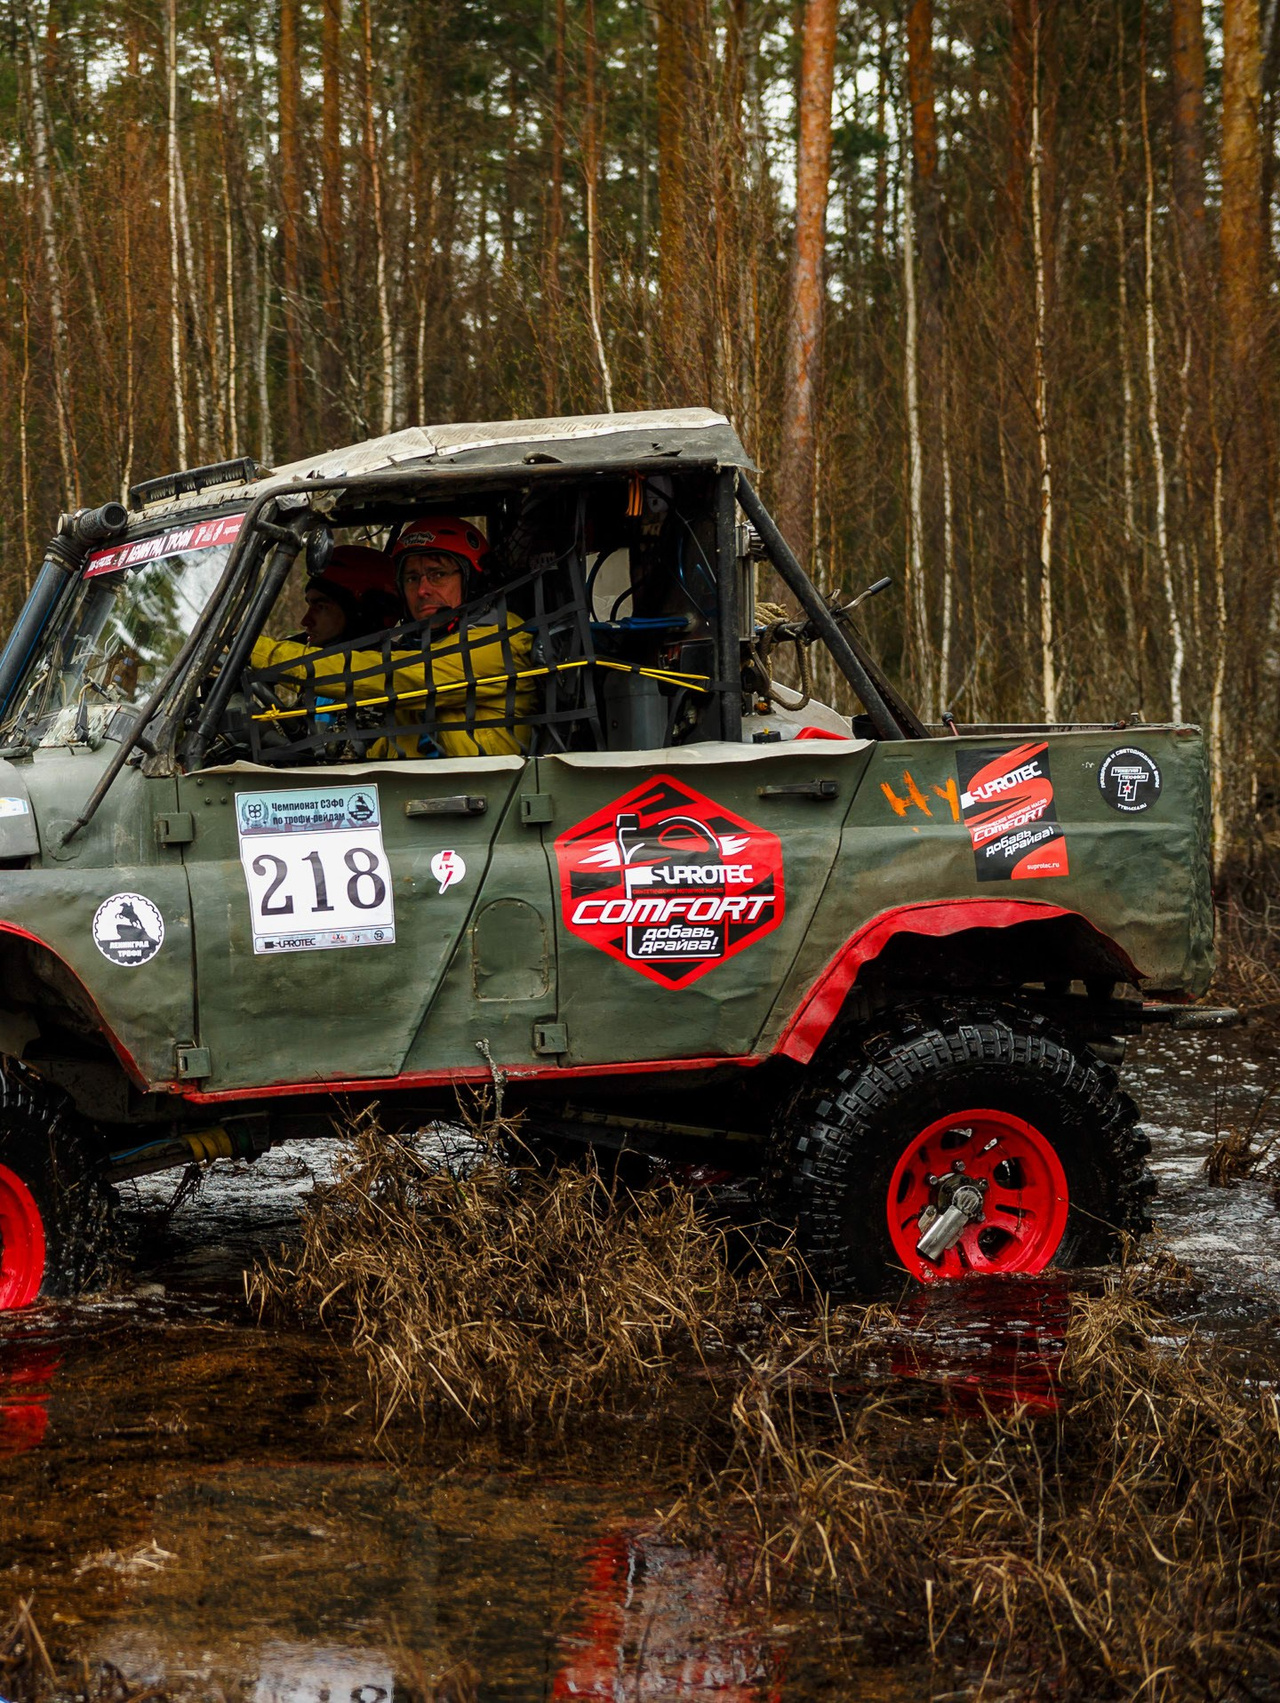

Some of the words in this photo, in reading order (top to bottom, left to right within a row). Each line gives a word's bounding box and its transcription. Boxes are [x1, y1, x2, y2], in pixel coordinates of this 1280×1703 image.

[966, 761, 1043, 803] SUPROTEC
[271, 800, 319, 812] Чемпионат
[320, 798, 345, 809] СЗФО
[272, 815, 284, 826] по
[284, 812, 346, 825] трофи-рейдам
[974, 804, 1048, 842] COMFORT
[985, 829, 1032, 858] добавь
[646, 864, 754, 886] SUPROTEC
[1026, 862, 1060, 871] suprotec.ru
[252, 847, 386, 916] 218
[571, 896, 776, 924] COMFORT
[268, 938, 316, 948] SUPROTEC
[641, 925, 715, 941] добавь
[638, 937, 718, 955] драйва!
